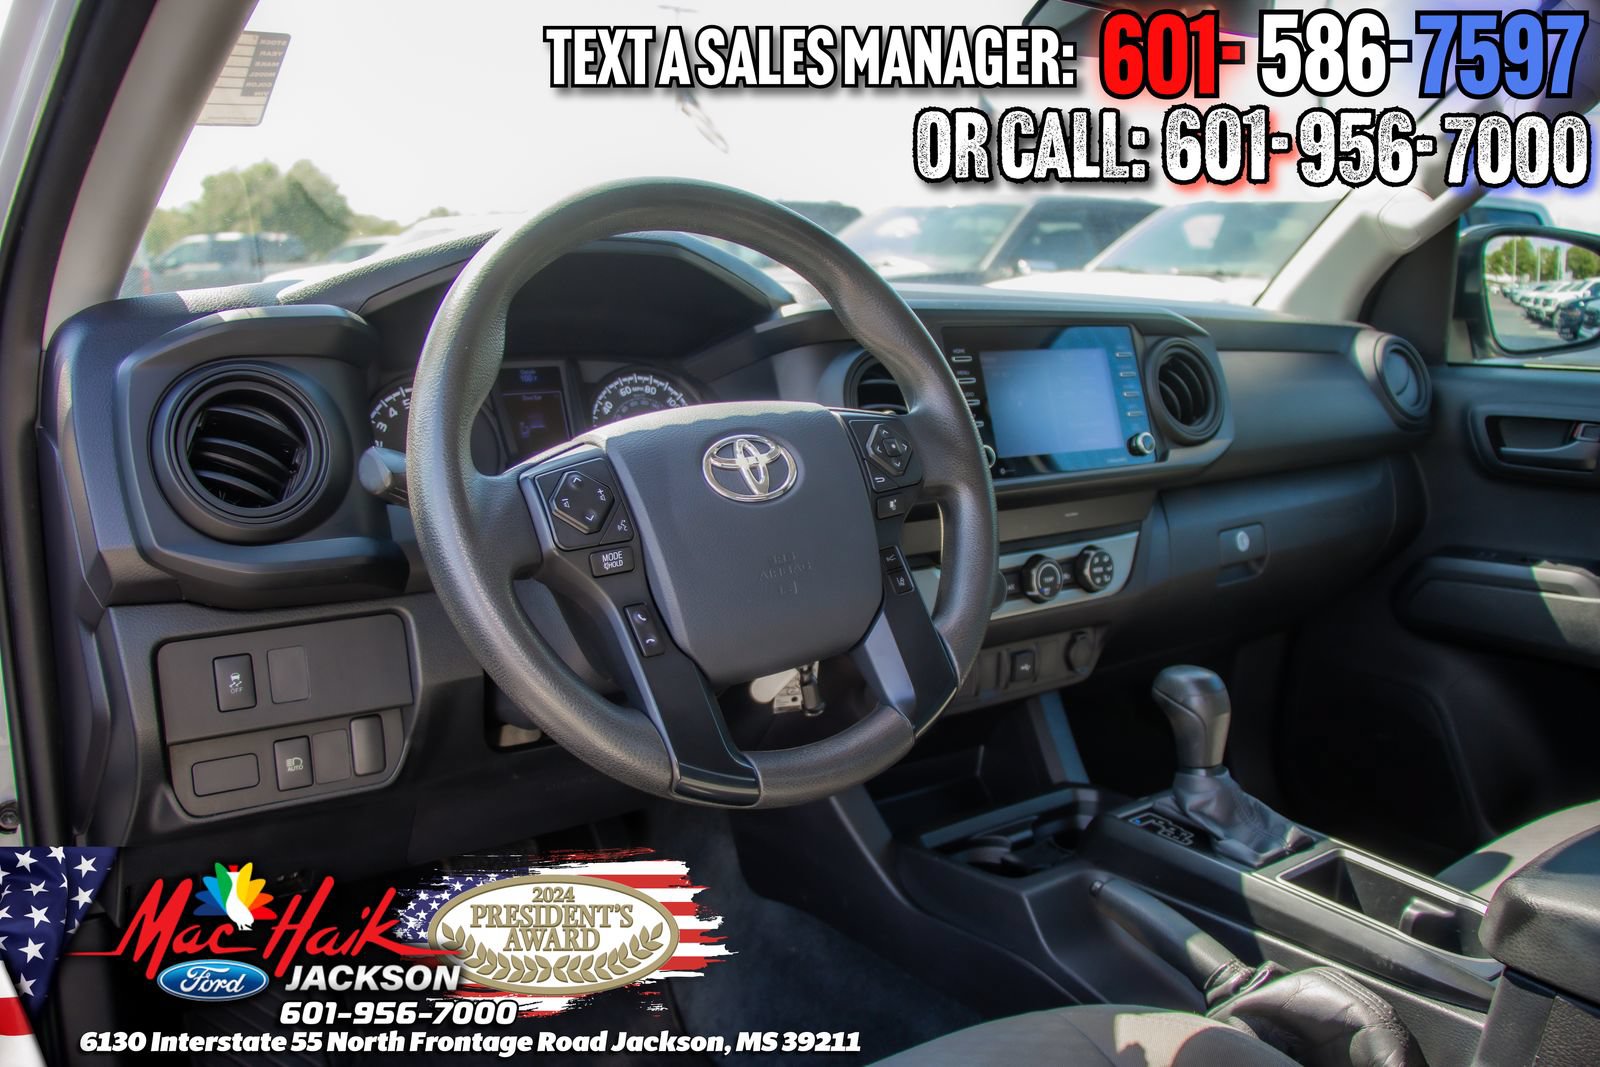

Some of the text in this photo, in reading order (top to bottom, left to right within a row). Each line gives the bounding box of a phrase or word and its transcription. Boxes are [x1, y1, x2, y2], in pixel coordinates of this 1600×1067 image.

[619, 386, 632, 397] 60
[644, 385, 657, 395] 80
[389, 407, 398, 418] 4
[376, 421, 388, 433] 3
[602, 550, 623, 563] MODE
[287, 763, 304, 772] AUTO
